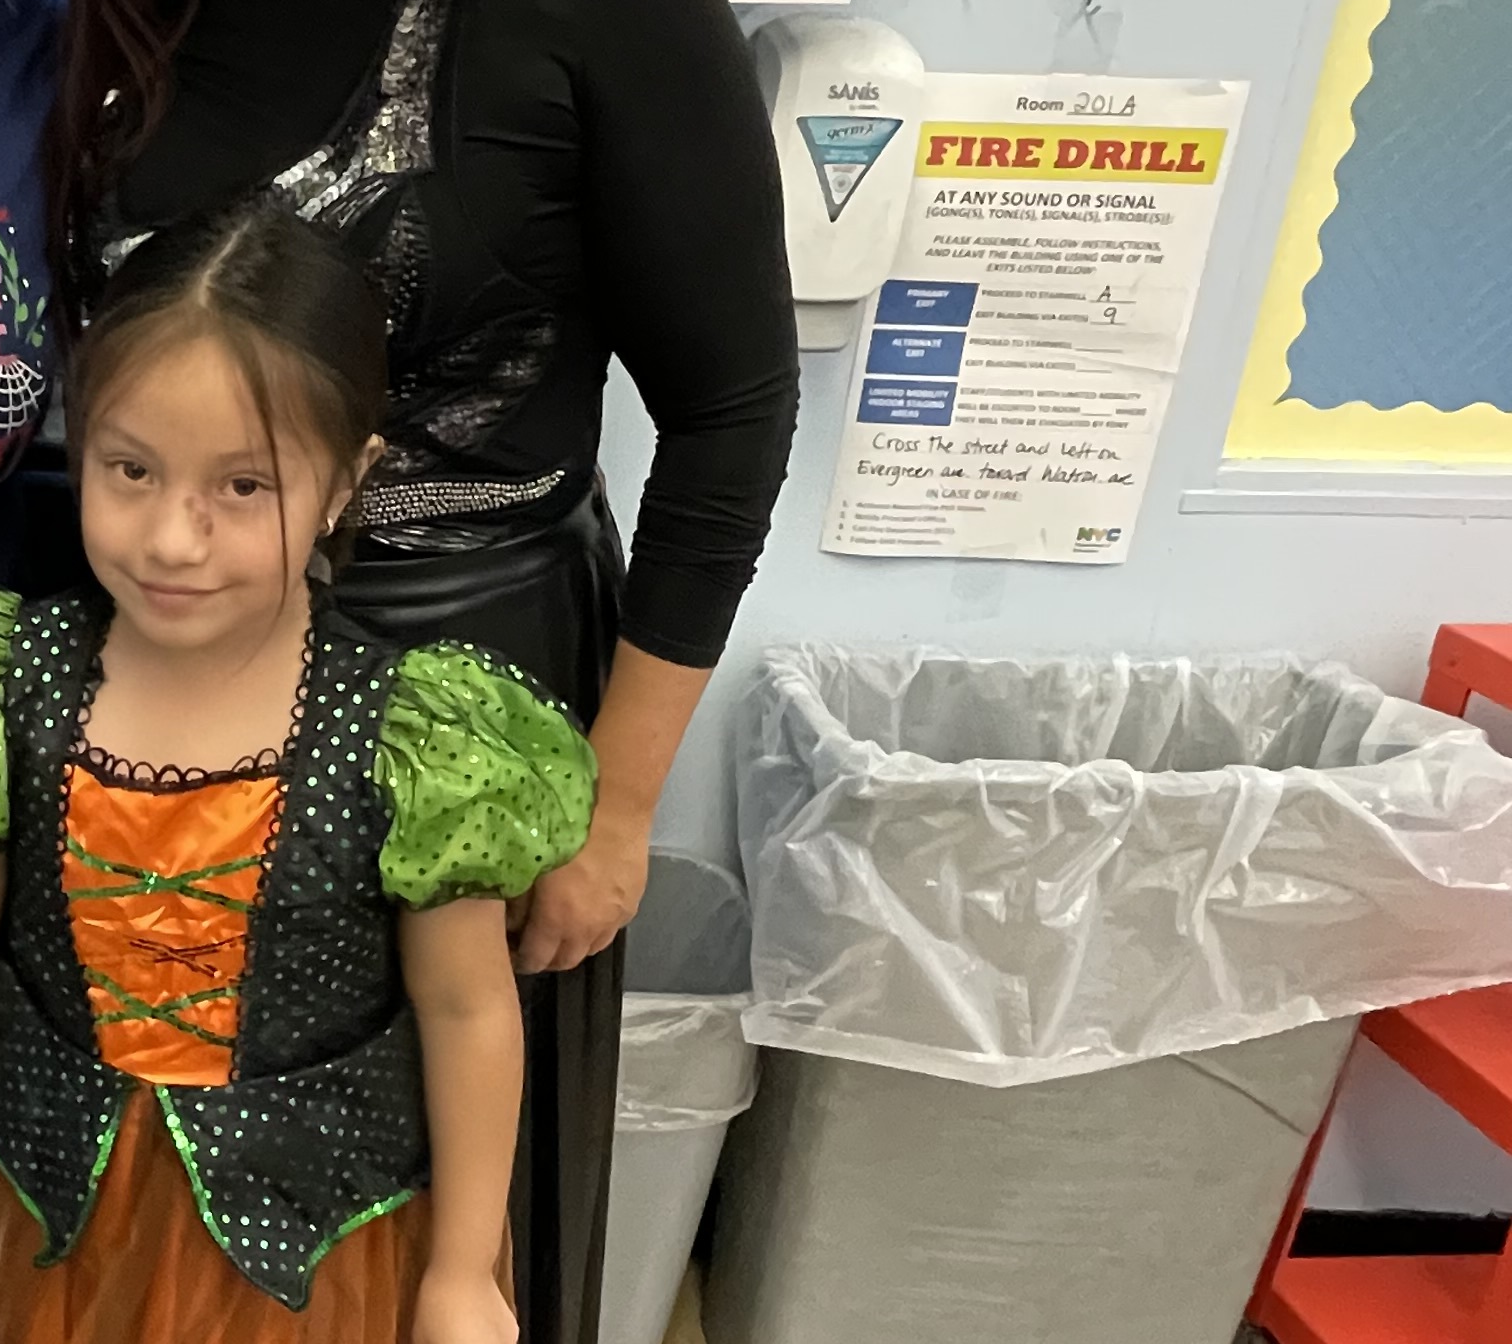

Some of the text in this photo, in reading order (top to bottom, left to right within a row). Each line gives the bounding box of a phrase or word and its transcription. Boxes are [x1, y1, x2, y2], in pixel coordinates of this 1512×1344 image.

[1016, 97, 1064, 112] Room
[925, 136, 1205, 173] FIRE DRILL
[934, 189, 1157, 210] AT ANY SOUND OR SIGNAL
[1095, 285, 1112, 303] A
[872, 431, 921, 453] Cross
[961, 436, 1009, 456] street
[1015, 441, 1051, 456] and
[857, 460, 934, 487] Evergreen
